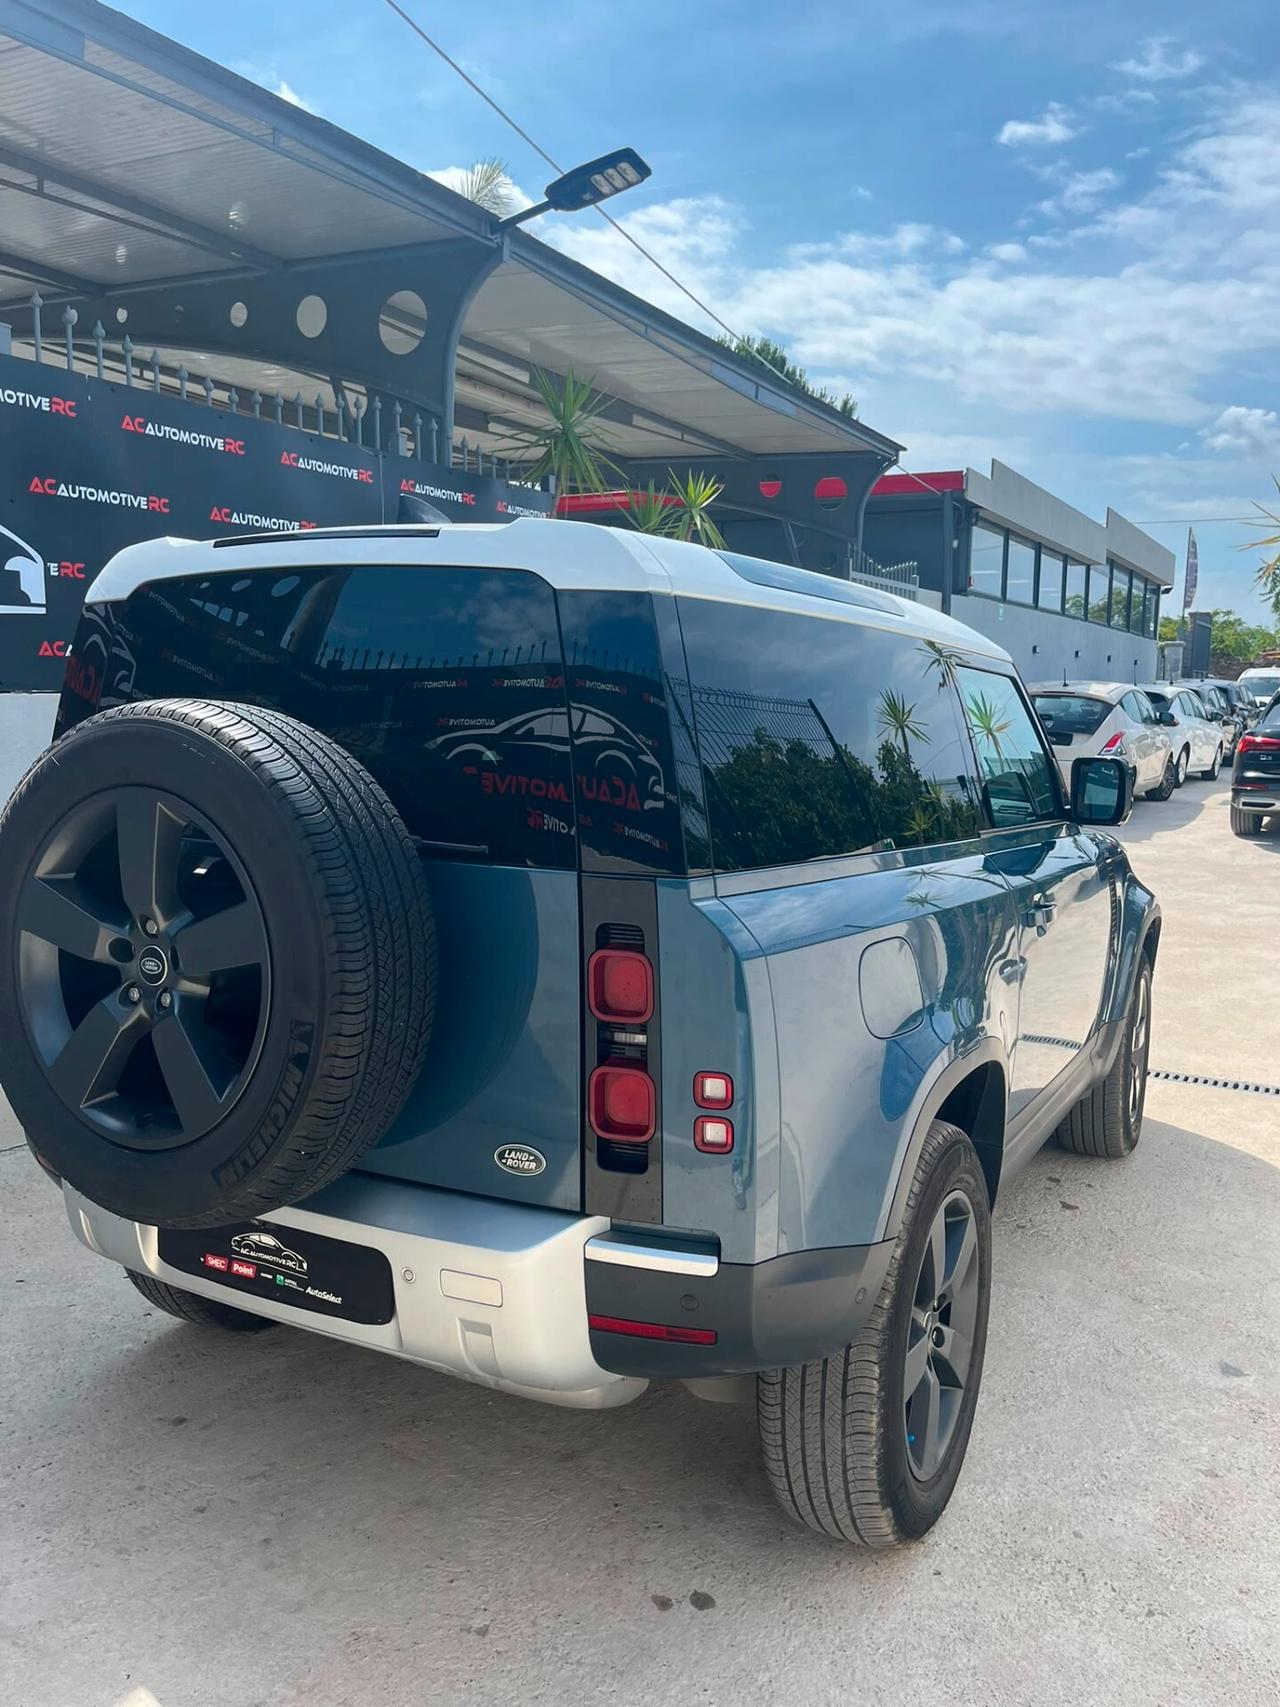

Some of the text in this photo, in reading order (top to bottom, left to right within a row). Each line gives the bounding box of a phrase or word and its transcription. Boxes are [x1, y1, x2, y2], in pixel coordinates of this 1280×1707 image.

[504, 1149, 529, 1161] LAND
[506, 1158, 536, 1170] ROVER
[305, 1285, 342, 1304] AutoSelect
